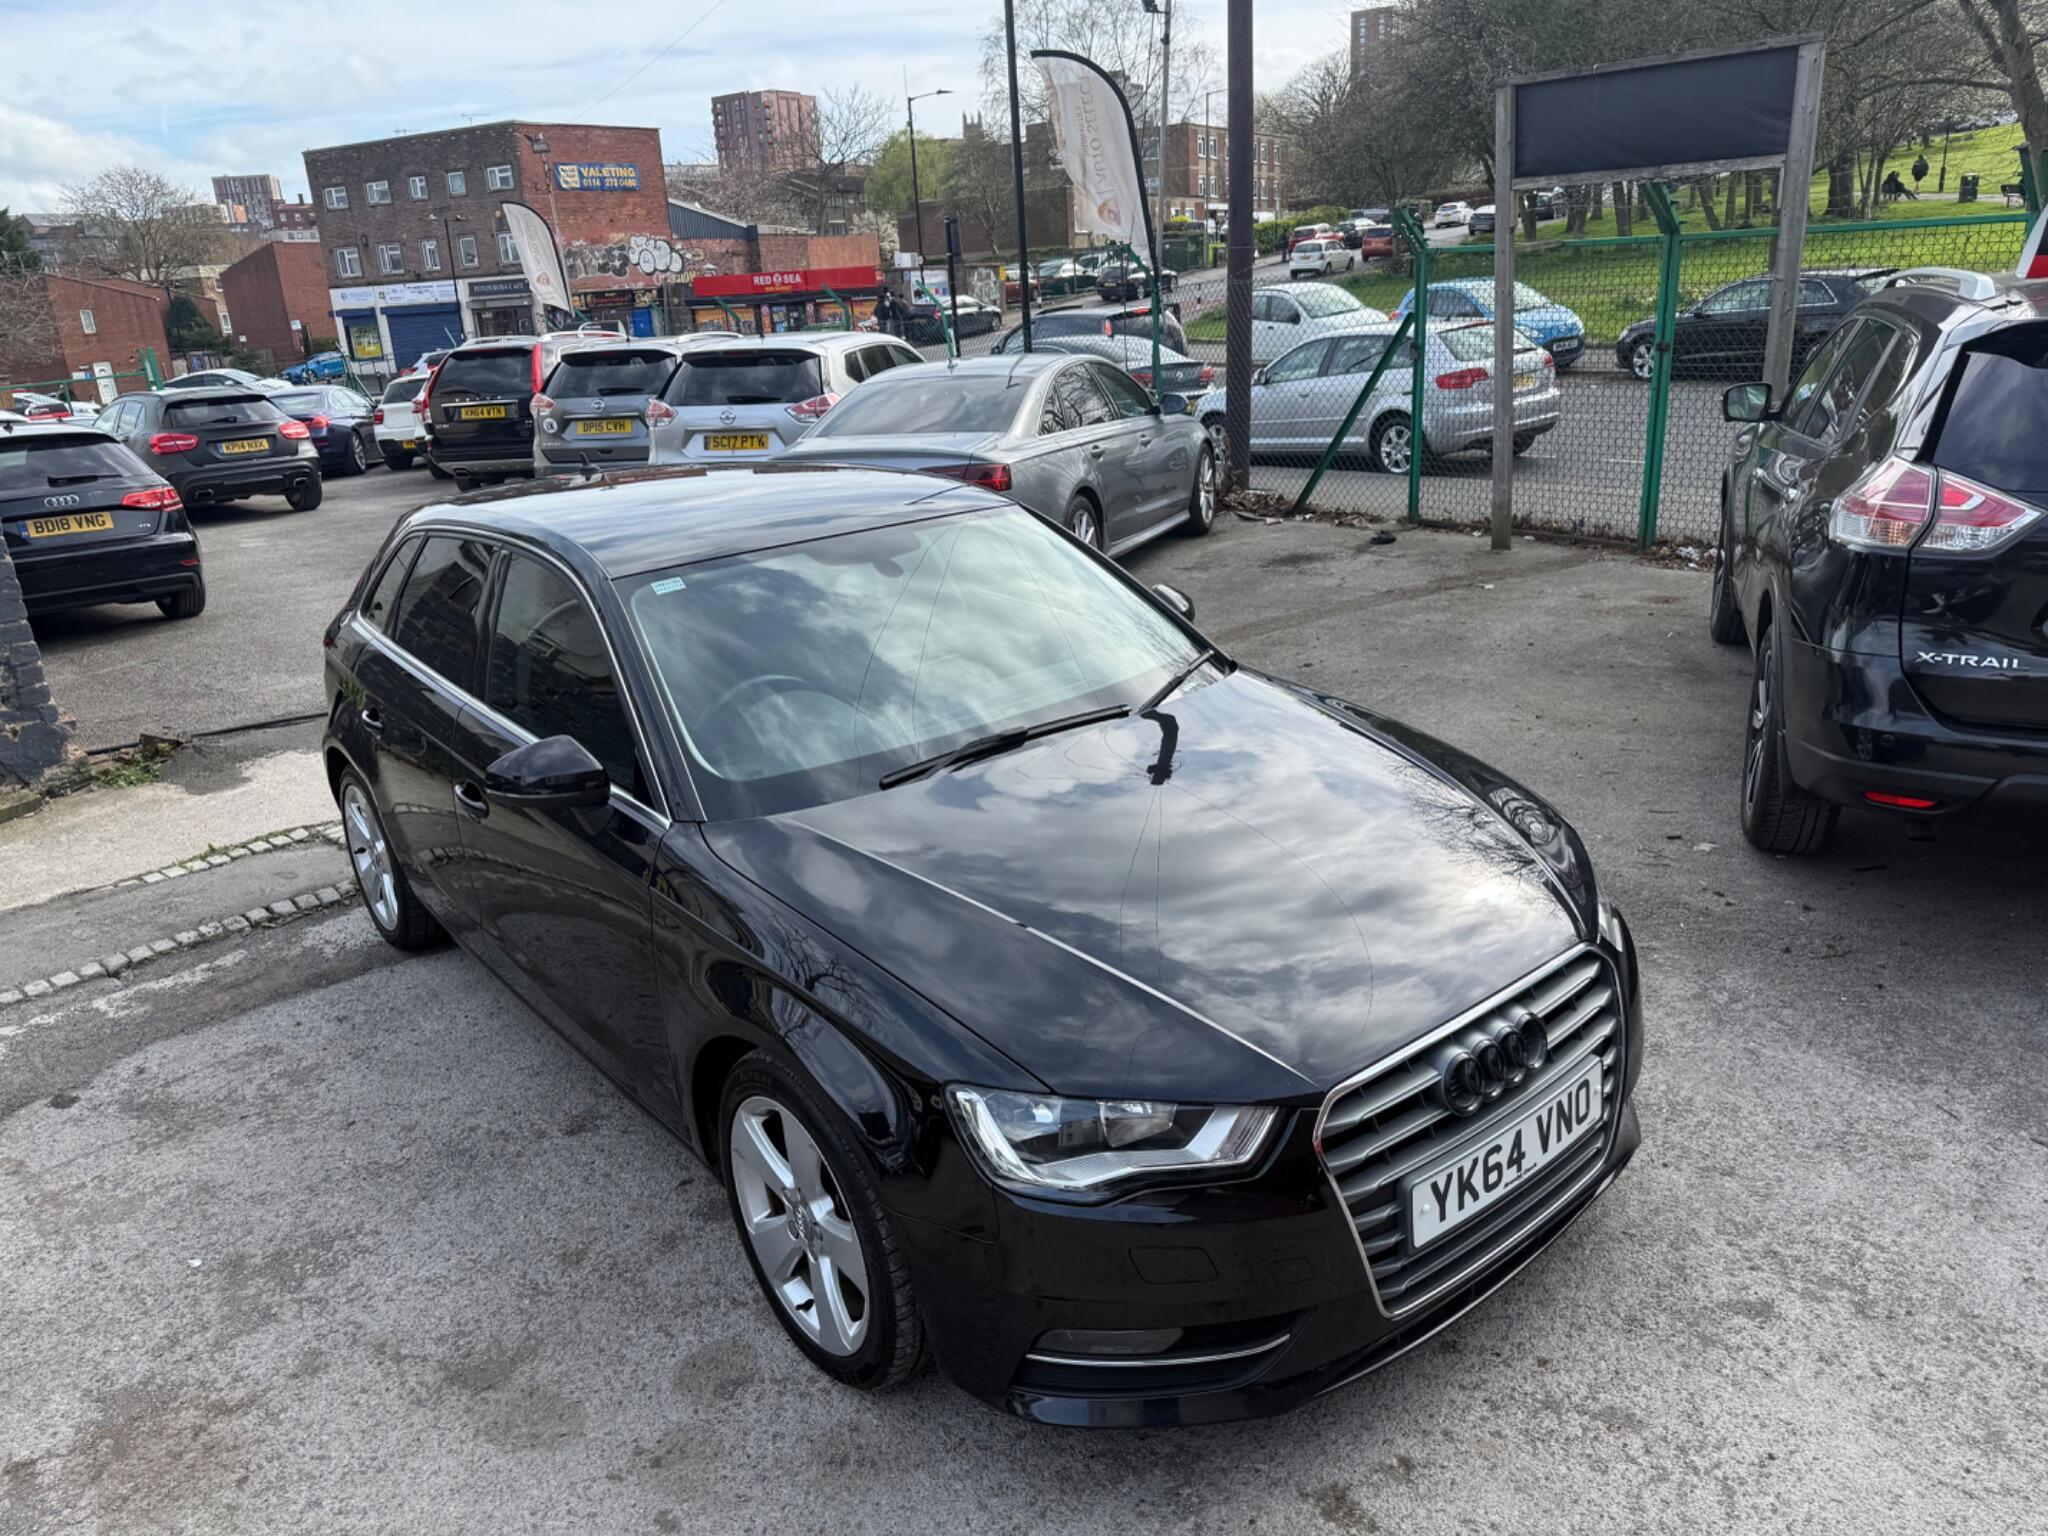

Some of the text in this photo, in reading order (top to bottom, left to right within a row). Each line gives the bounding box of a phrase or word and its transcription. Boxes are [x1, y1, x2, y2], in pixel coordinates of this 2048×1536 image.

[580, 166, 636, 177] VALETING
[753, 273, 802, 286] RED SEA
[583, 421, 605, 432] DP15
[713, 435, 738, 448] SC17
[33, 514, 106, 534] BD18 VNG
[1915, 651, 2030, 669] X-TRAIL
[1430, 1078, 1591, 1224] YK64 VNO
